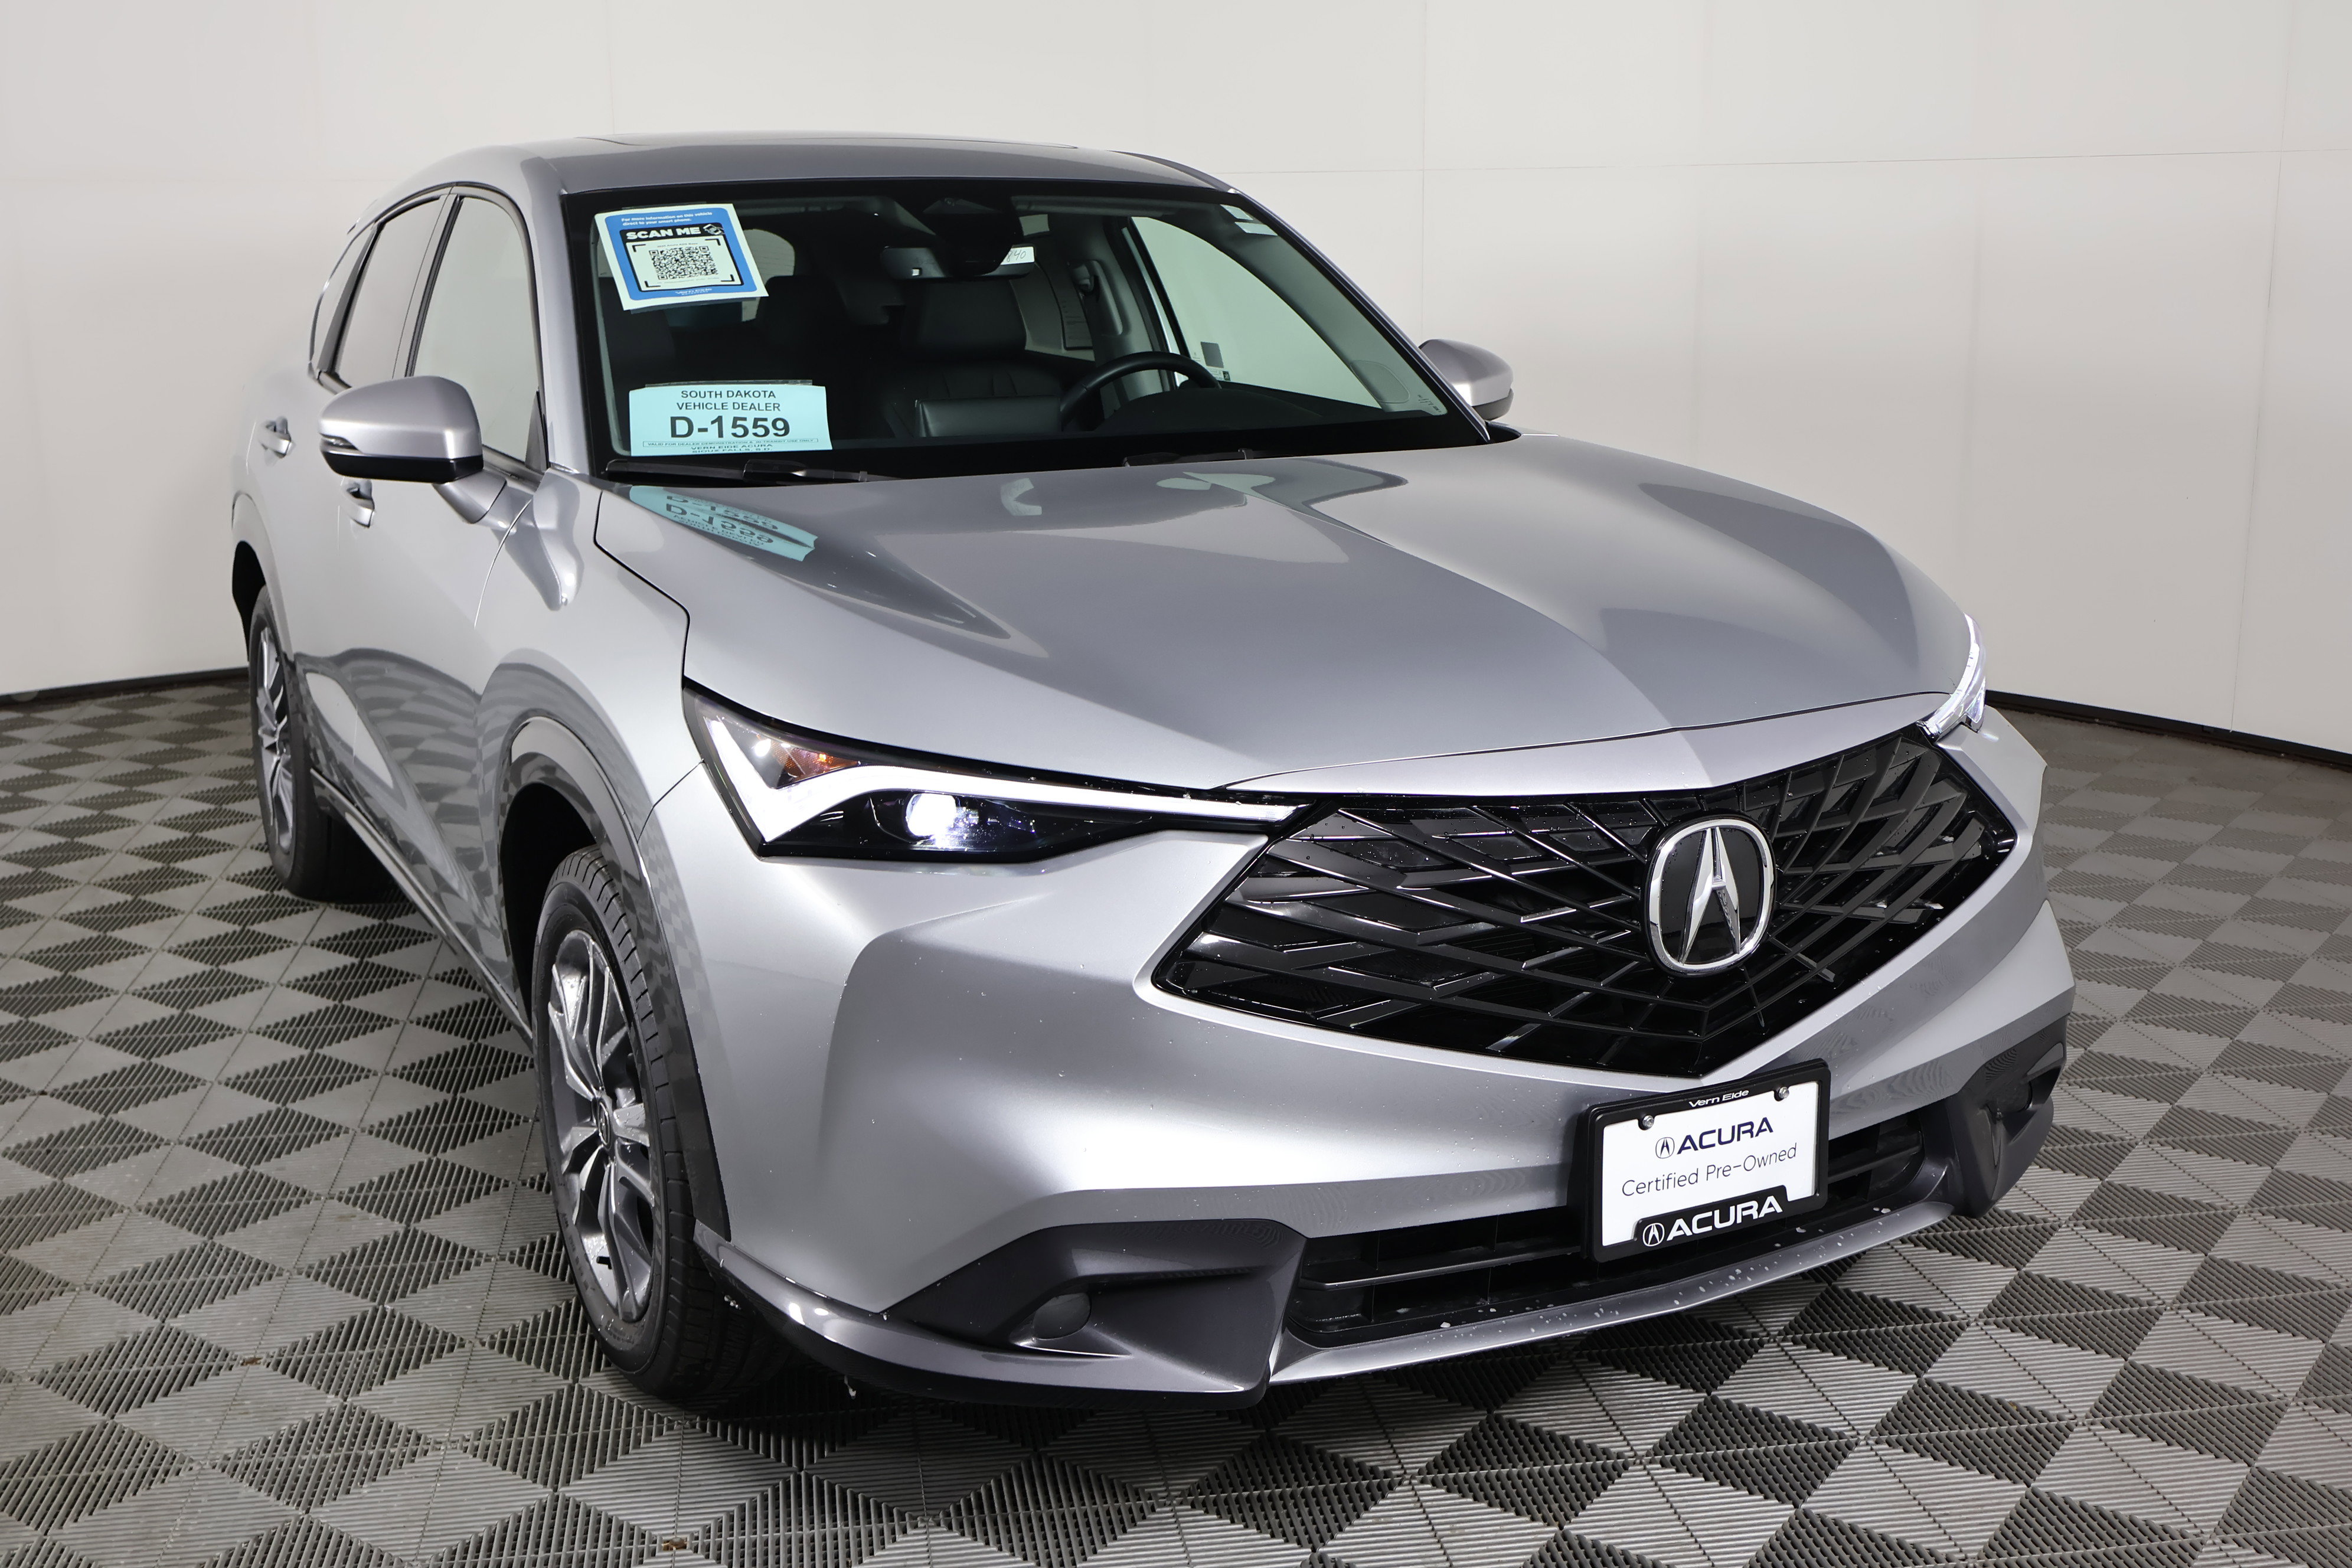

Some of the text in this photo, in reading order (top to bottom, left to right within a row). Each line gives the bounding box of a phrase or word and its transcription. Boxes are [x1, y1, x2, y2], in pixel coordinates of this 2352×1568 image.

[626, 227, 701, 240] SCAN ME
[681, 390, 776, 398] SOUTH DAKOTA
[733, 403, 780, 411] DEALER
[670, 416, 790, 438] D-1559
[1689, 1097, 1720, 1108] Vern
[1677, 1117, 1773, 1155] ACURA
[1622, 1142, 1797, 1197] Certified Pre-Owned
[1667, 1196, 1783, 1241] ACURA
